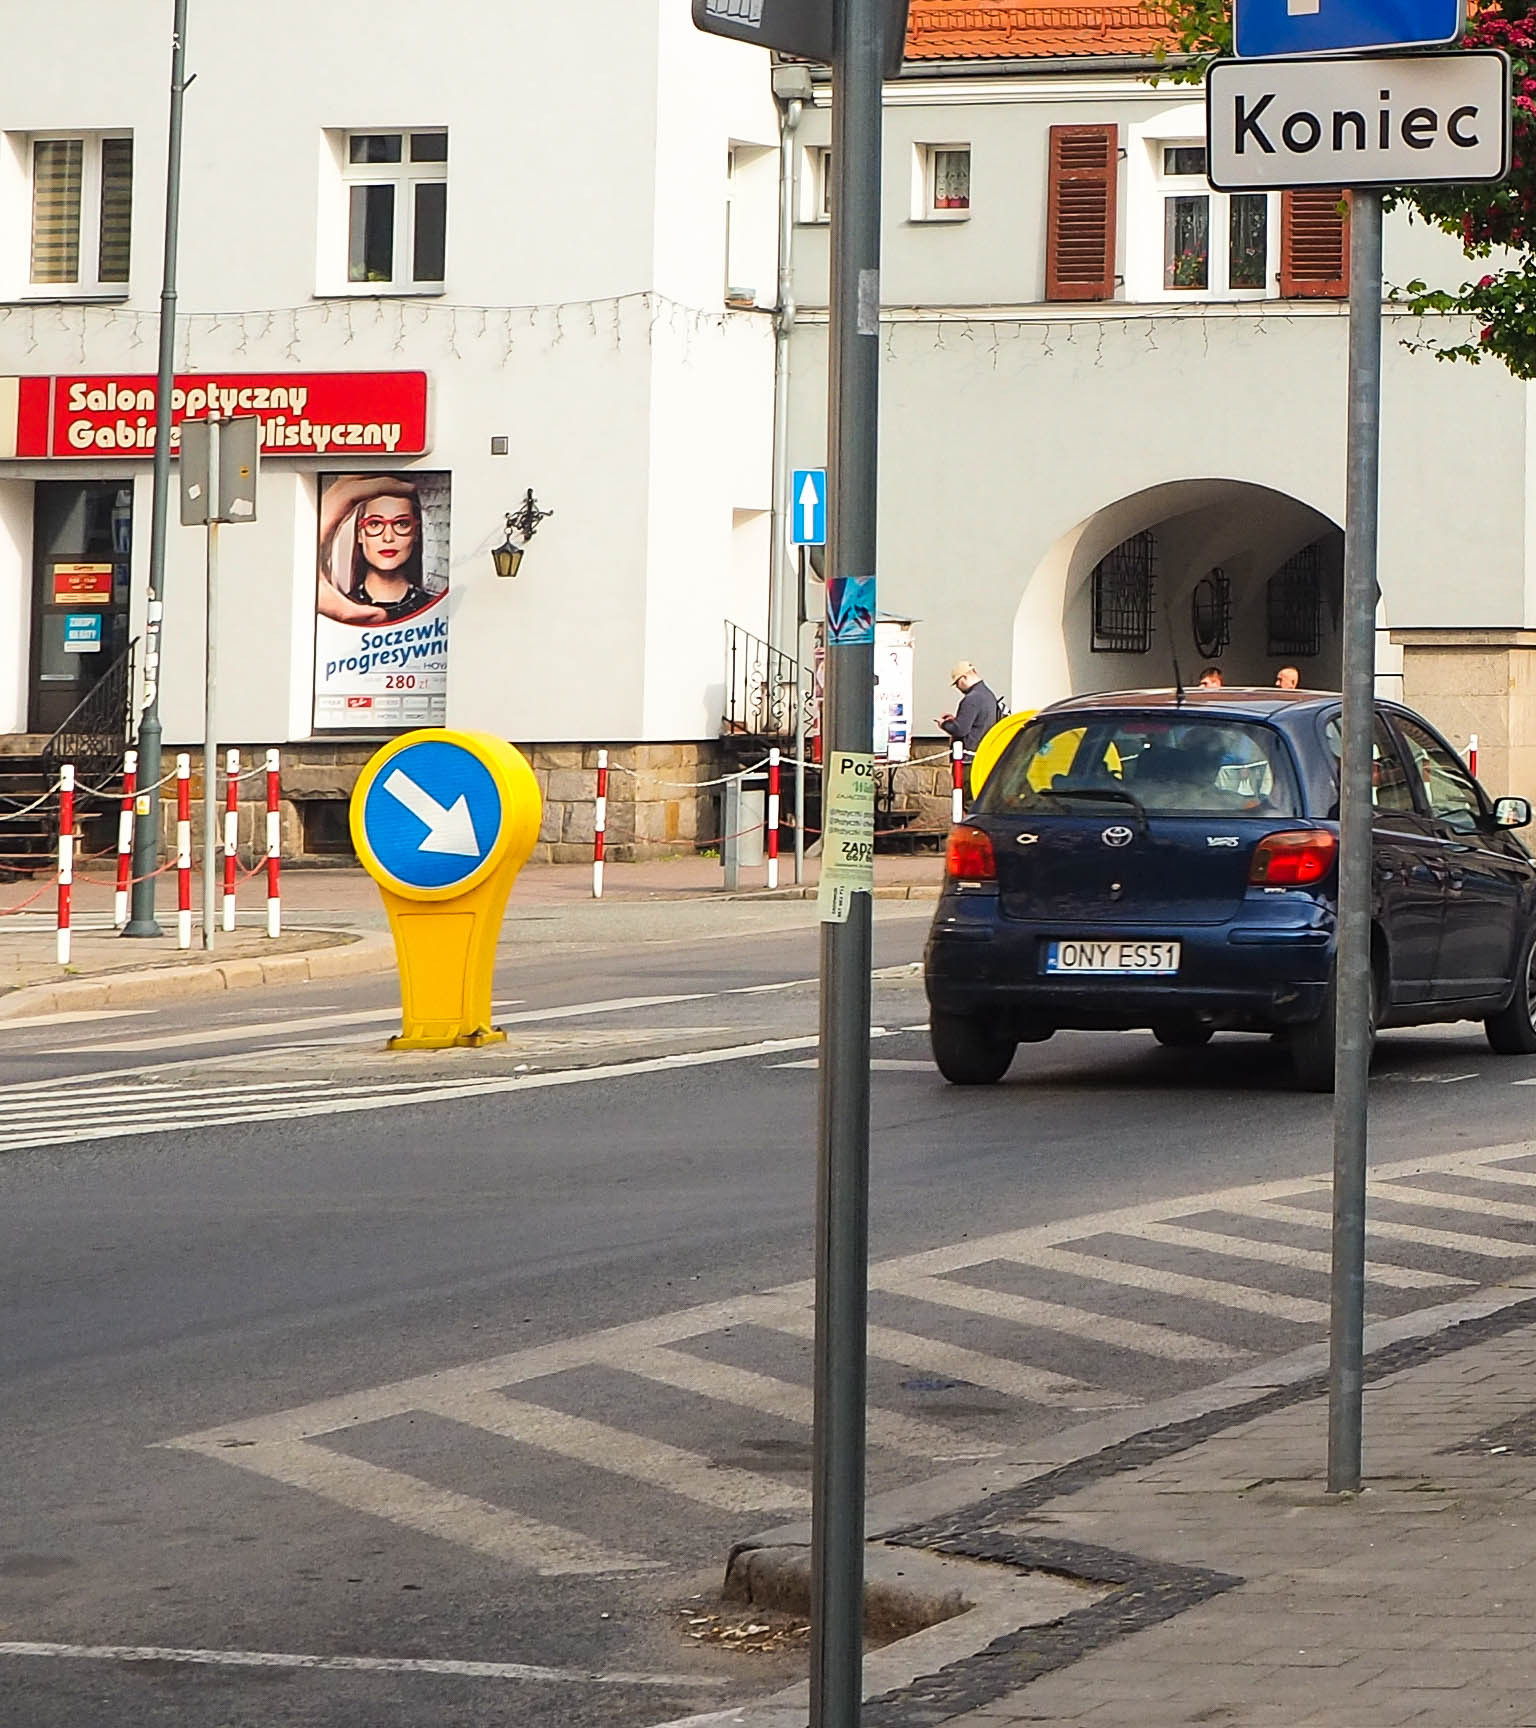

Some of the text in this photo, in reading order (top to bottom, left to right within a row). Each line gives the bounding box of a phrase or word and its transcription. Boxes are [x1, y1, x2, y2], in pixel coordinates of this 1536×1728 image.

[1233, 89, 1480, 154] Koniec
[68, 383, 308, 416] Salon optyczny
[385, 675, 416, 689] 280
[1062, 944, 1175, 968] ONY ES51
